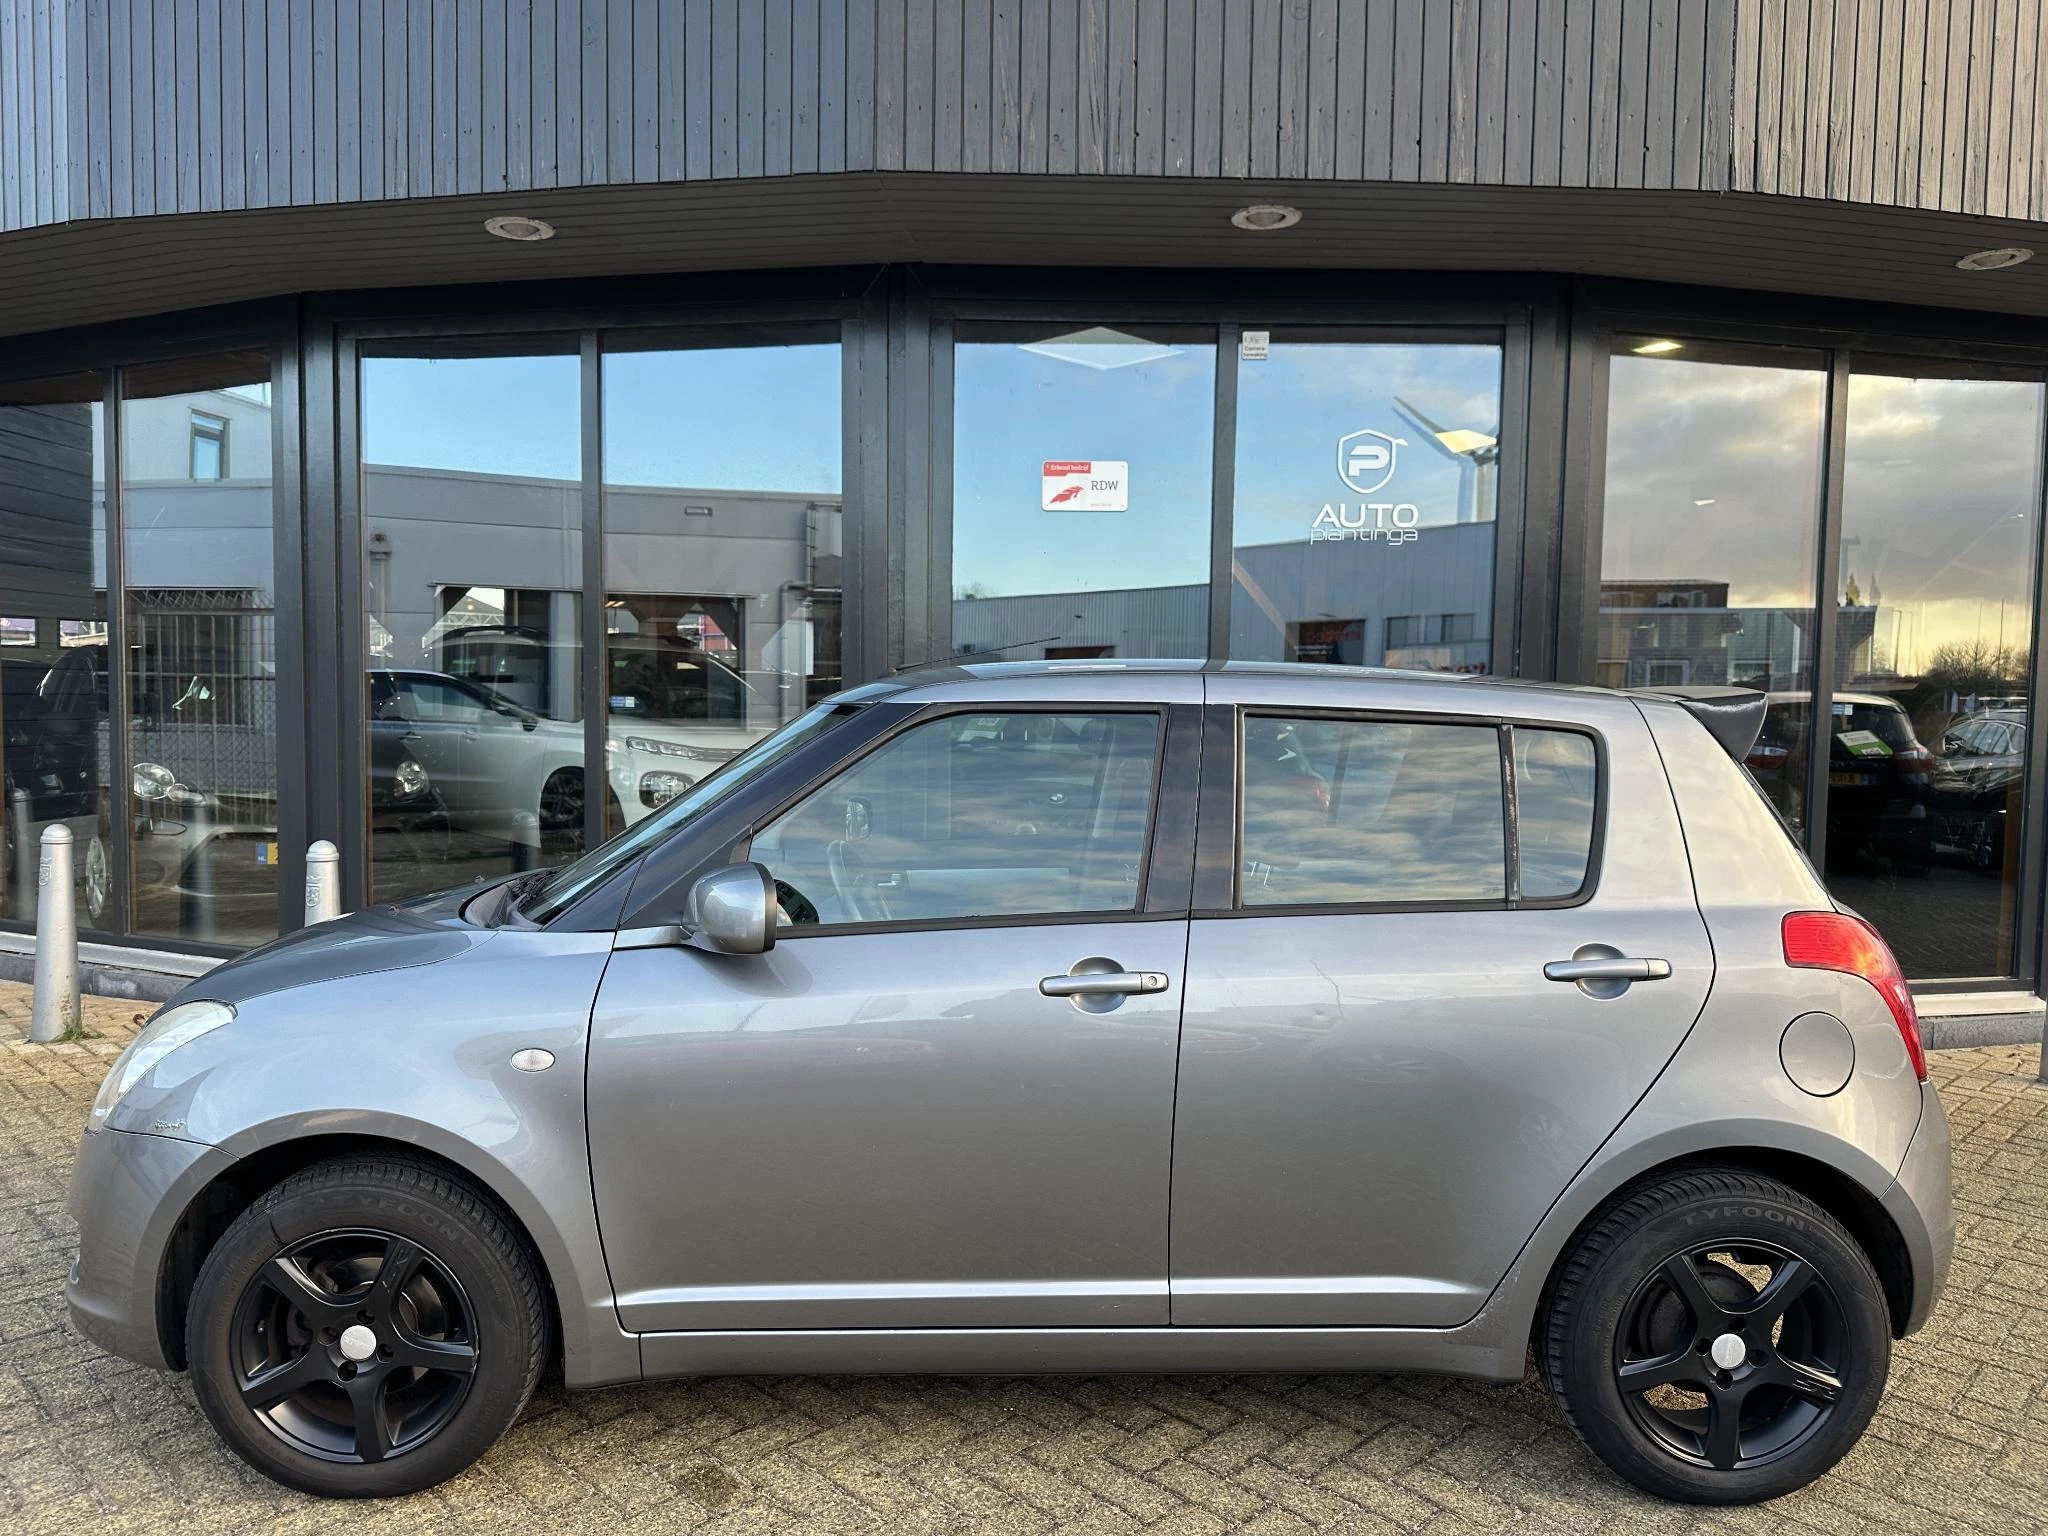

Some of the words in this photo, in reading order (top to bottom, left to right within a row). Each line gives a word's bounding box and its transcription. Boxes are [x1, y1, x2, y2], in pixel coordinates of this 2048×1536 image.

[1347, 445, 1390, 477] P
[1091, 480, 1119, 491] RDW
[1311, 503, 1419, 528] AUTO
[1310, 527, 1419, 546] plantinga
[333, 1195, 461, 1242] TYFOON
[1679, 1206, 1805, 1232] TYFOON
